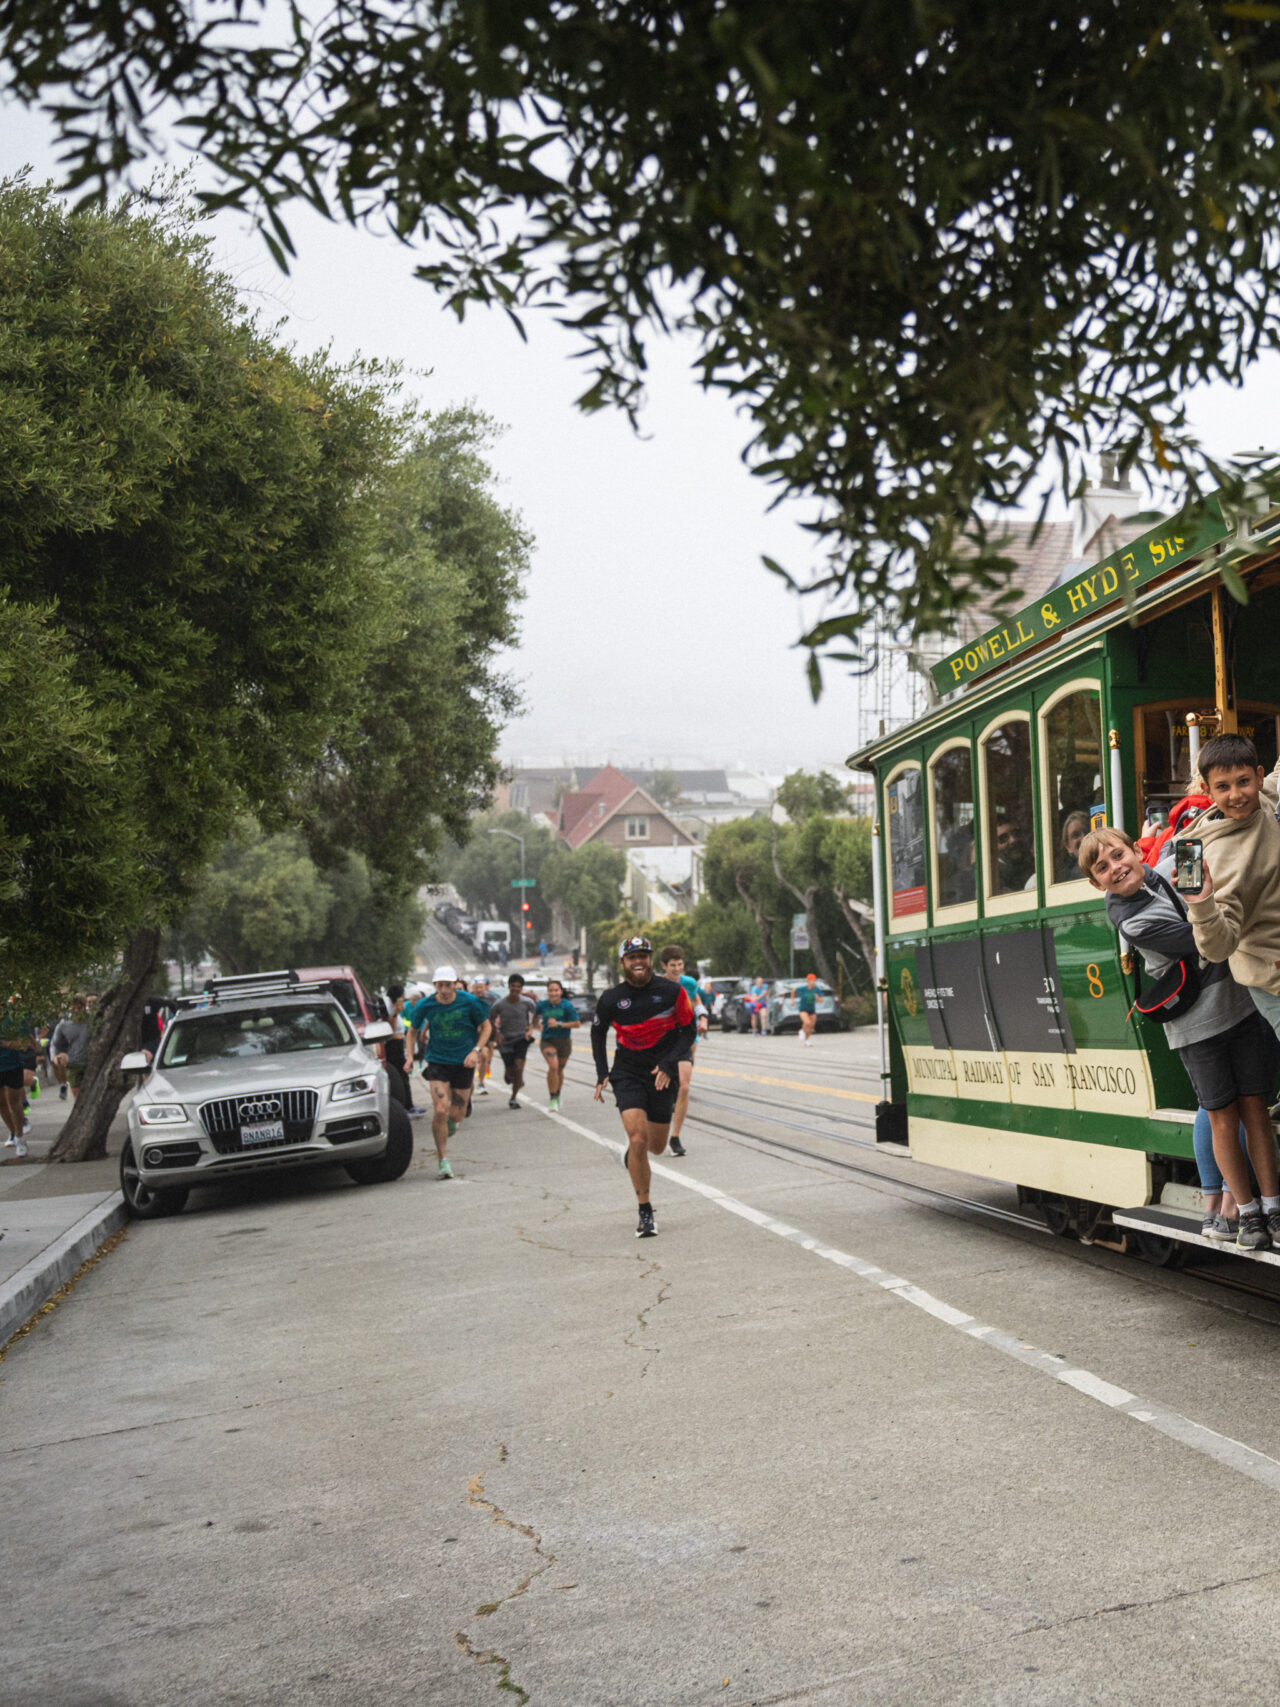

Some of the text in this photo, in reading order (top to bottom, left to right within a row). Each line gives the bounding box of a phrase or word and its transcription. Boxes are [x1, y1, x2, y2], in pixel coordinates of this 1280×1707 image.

[949, 620, 1035, 681] POWELL
[1040, 603, 1061, 629] &
[1066, 552, 1140, 613] HYDE
[1086, 963, 1104, 998] 8
[912, 1057, 958, 1081] MUNICIPAL
[1009, 1062, 1021, 1085] OF
[1032, 1062, 1056, 1088] SAN
[1063, 1064, 1137, 1095] FRANCISCO
